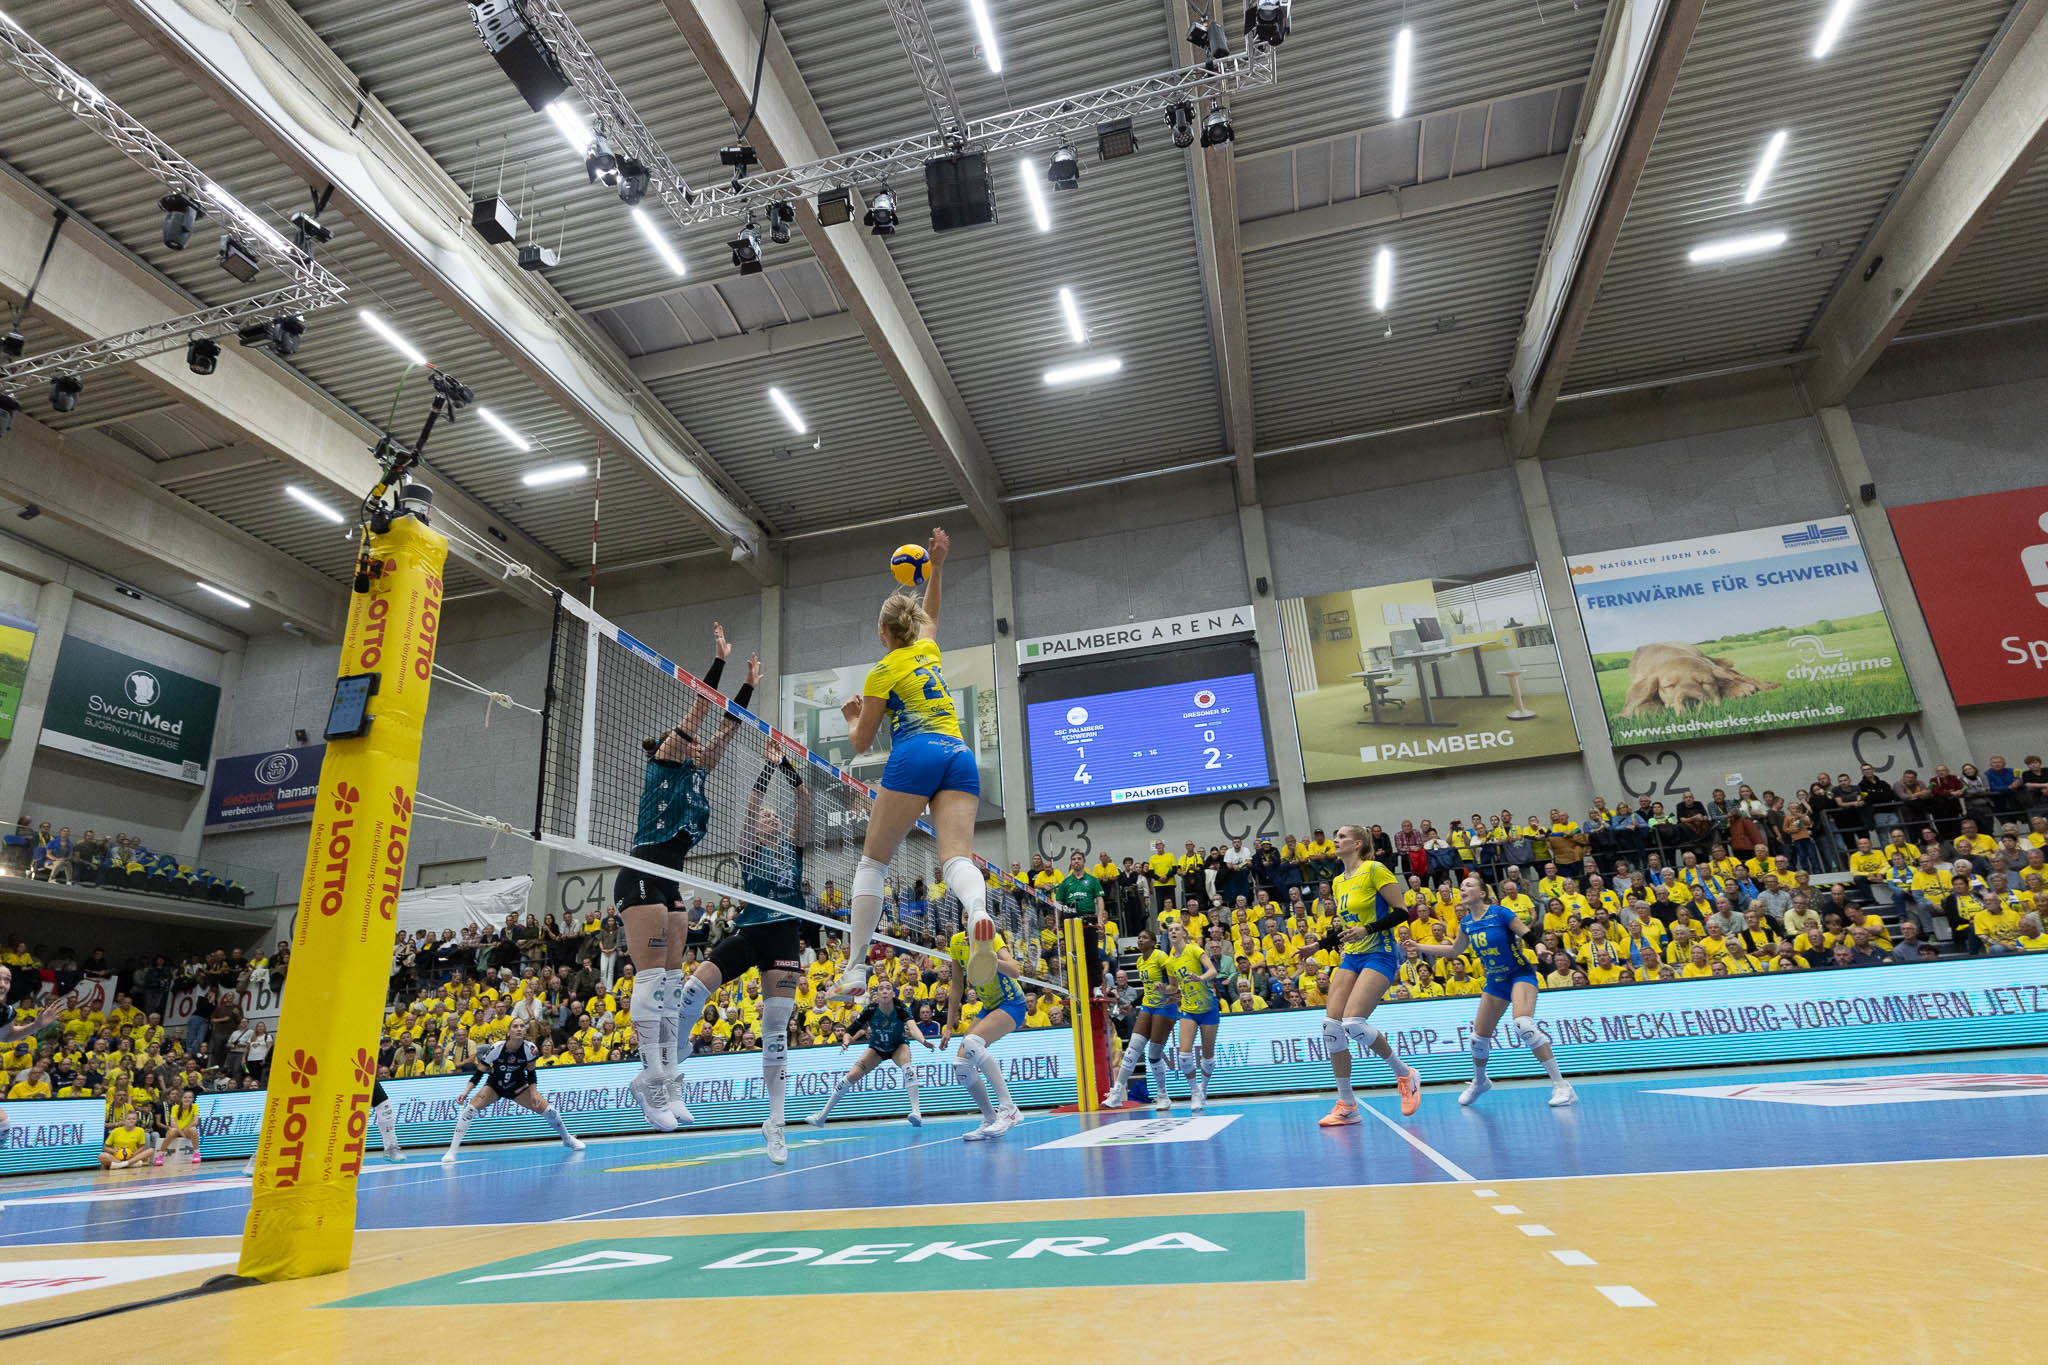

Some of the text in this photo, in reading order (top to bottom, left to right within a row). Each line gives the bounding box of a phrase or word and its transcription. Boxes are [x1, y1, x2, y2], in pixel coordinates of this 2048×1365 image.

[1599, 547, 1721, 571] NATÜRLICH JEDEN TAG.
[1586, 560, 1860, 610] FERNWÄRME FÜR SCHWERIN
[414, 596, 439, 681] LOTTO
[1042, 613, 1245, 655] PALMBERG ARENA
[1786, 657, 1893, 681] citywärme
[88, 694, 184, 735] SweriMed
[1068, 724, 1104, 734] PALMBERG
[1619, 703, 1845, 739] www.stadtwerke-schwerin.de
[122, 727, 180, 751] WALLSTABE
[1076, 746, 1085, 759] 1
[1203, 729, 1216, 743] 0
[1380, 730, 1514, 761] PALMBERG
[1851, 720, 1924, 773] C1
[1073, 763, 1092, 785] 4
[1202, 747, 1222, 770] 2
[1618, 750, 1690, 799] C2
[1125, 785, 1187, 799] PALMBERG
[221, 802, 274, 817] werbetechnik
[1219, 796, 1279, 841] C2
[1037, 817, 1092, 862] C3
[298, 823, 325, 946] Mecklenburg-Vorpommern
[320, 819, 354, 917] LOTTO
[360, 820, 384, 944] Mecklenburg-Vorpommern
[561, 872, 606, 914] C4
[1471, 931, 1488, 949] 18
[879, 1033, 889, 1042] 11
[1271, 1038, 1304, 1064] DIE
[1397, 1029, 1438, 1056] APP
[1505, 1020, 1553, 1048] US
[1555, 1017, 1599, 1046] INS
[503, 1072, 512, 1083] 9
[396, 1097, 427, 1124] FÜR
[429, 1100, 458, 1121] UNS
[699, 1230, 1228, 1270] DEKRA
